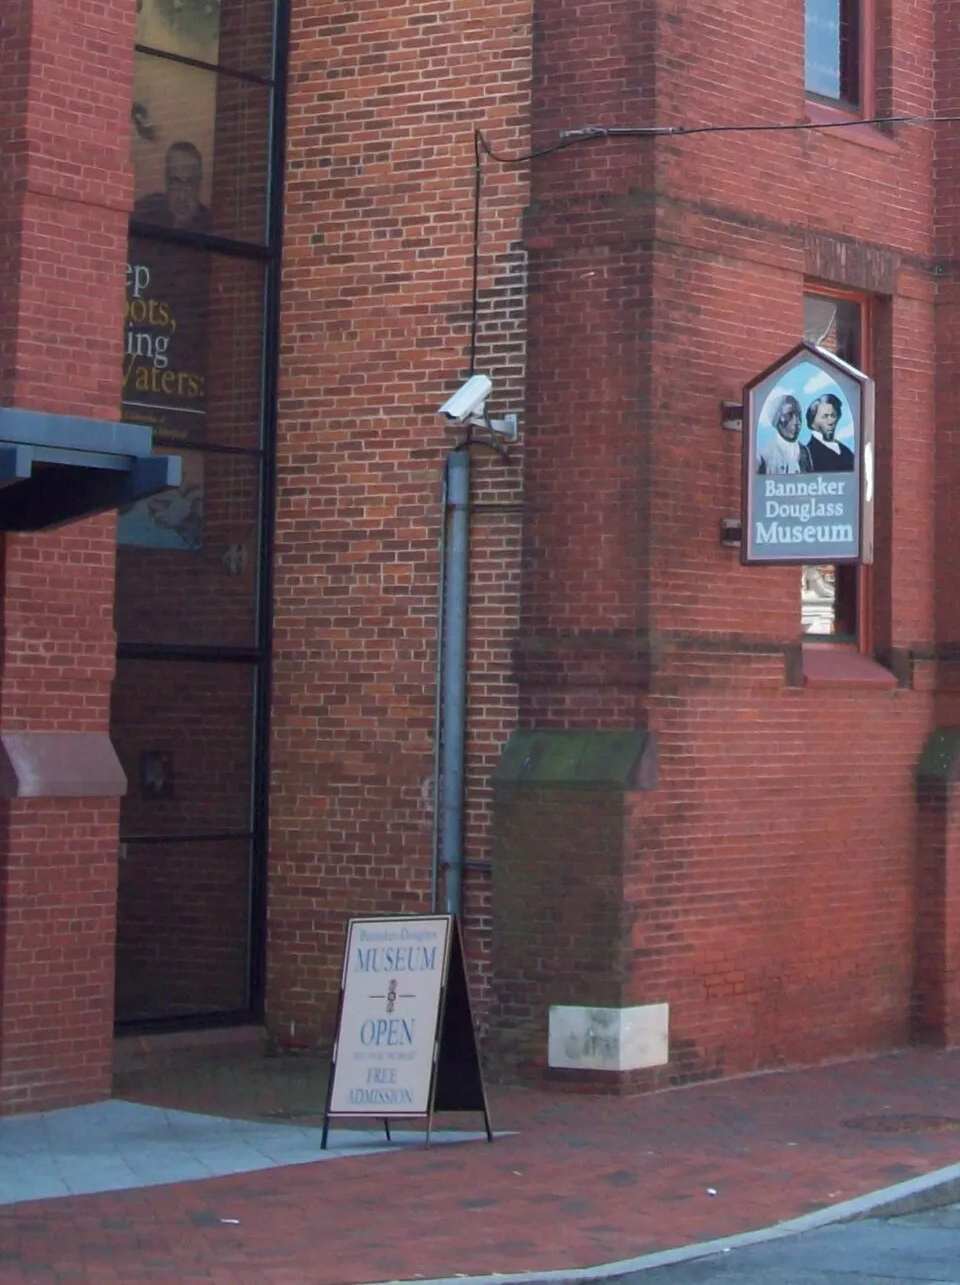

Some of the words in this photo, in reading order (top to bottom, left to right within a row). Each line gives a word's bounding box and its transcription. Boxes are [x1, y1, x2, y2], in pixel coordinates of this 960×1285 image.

[124, 262, 150, 297] ep
[124, 298, 177, 333] ots,
[124, 322, 170, 368] ing
[765, 477, 846, 496] Banneker
[765, 499, 844, 522] Douglass
[756, 521, 854, 544] Museum
[355, 946, 437, 972] MUSEUM
[360, 1018, 415, 1046] OPEN
[366, 1067, 398, 1085] FREE
[346, 1088, 413, 1104] ADMISSION
